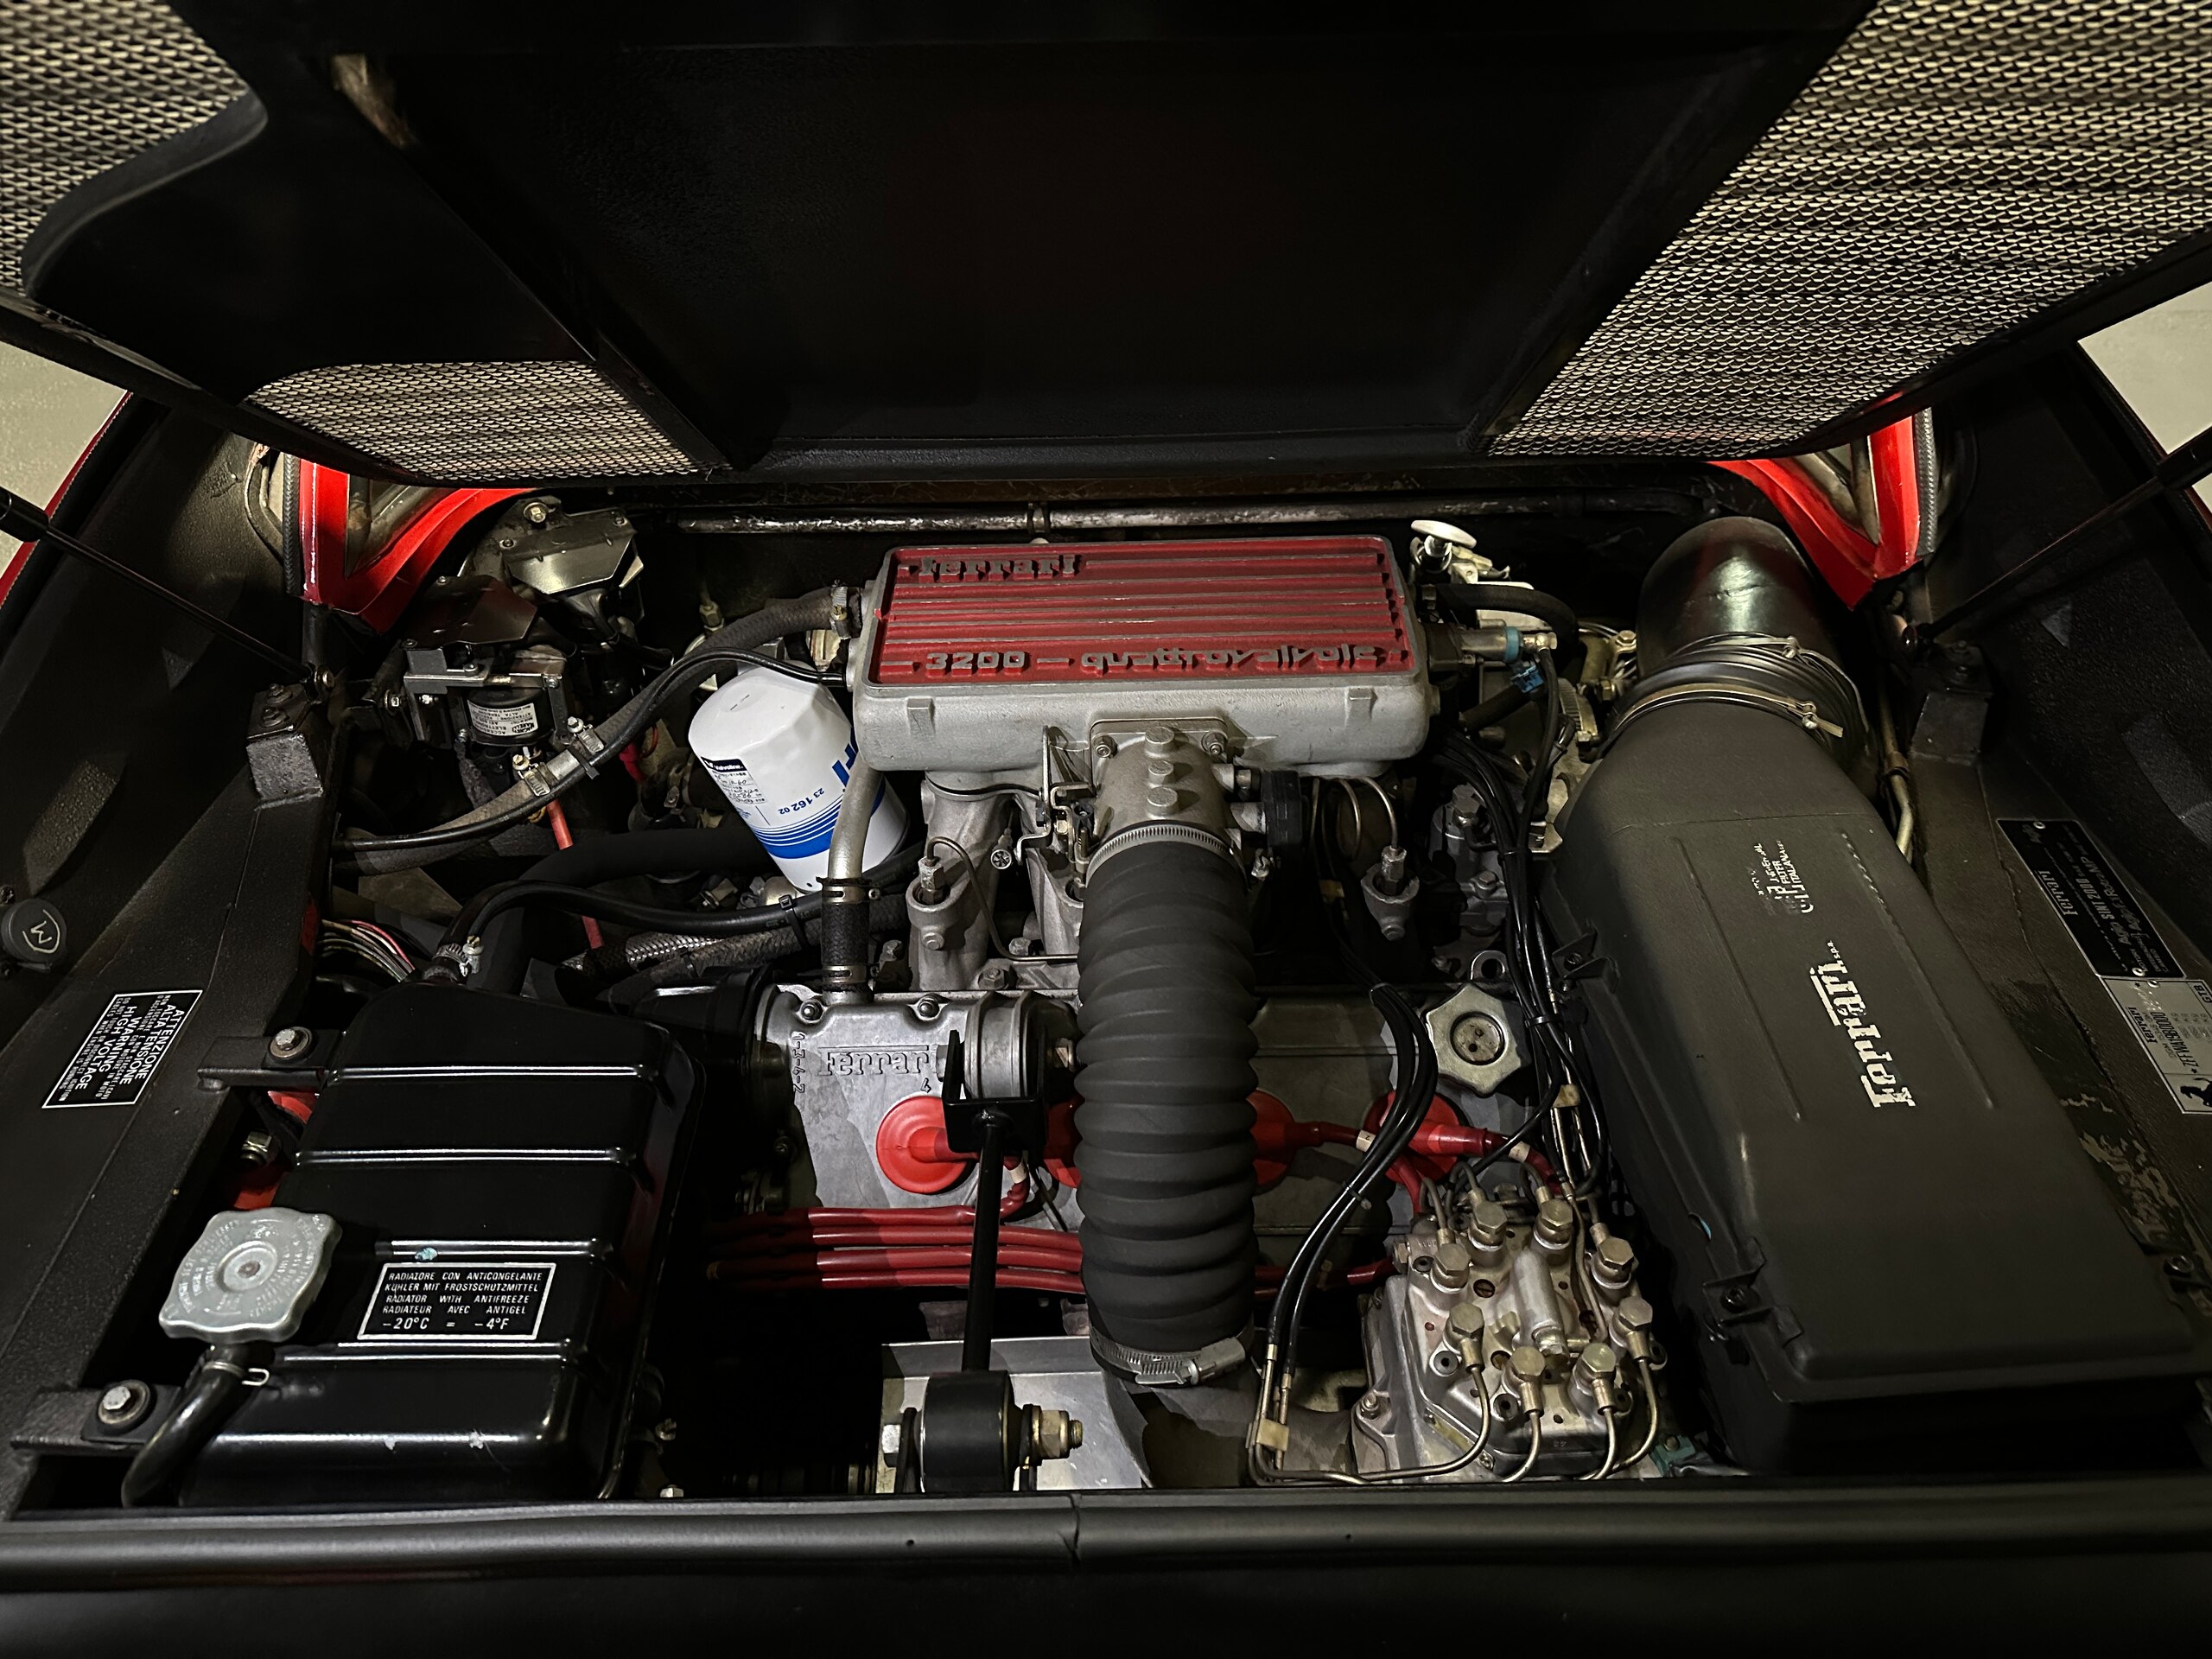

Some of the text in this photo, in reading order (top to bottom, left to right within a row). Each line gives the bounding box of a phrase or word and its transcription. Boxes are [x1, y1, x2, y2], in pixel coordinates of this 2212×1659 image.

[925, 648, 1028, 675] 3200
[813, 787, 825, 798] 23
[791, 797, 813, 811] 162
[2035, 870, 2078, 915] Ferrari
[2075, 878, 2101, 899] 2000
[2091, 901, 2115, 919] SINT
[2125, 1007, 2158, 1043] Ferrari
[74, 1006, 137, 1090] HIGH VOLTAGE
[99, 1016, 142, 1072] WARNING
[119, 1004, 176, 1084] ALTA TENSIONE
[135, 1009, 184, 1079] ATTENZIONE
[111, 1048, 130, 1070] MOTORE
[111, 1055, 133, 1083] STACCARE
[95, 1080, 111, 1097] MOTO
[920, 1077, 931, 1093] 4
[442, 1272, 461, 1281] CON
[467, 1272, 543, 1281] ANTICONGELANTE
[444, 1283, 538, 1292] FROSTSCHUTZMITTEL
[386, 1294, 428, 1303] RADIATOR
[474, 1294, 530, 1303] ANTIFREEZE
[486, 1306, 526, 1314] ANTIGEL
